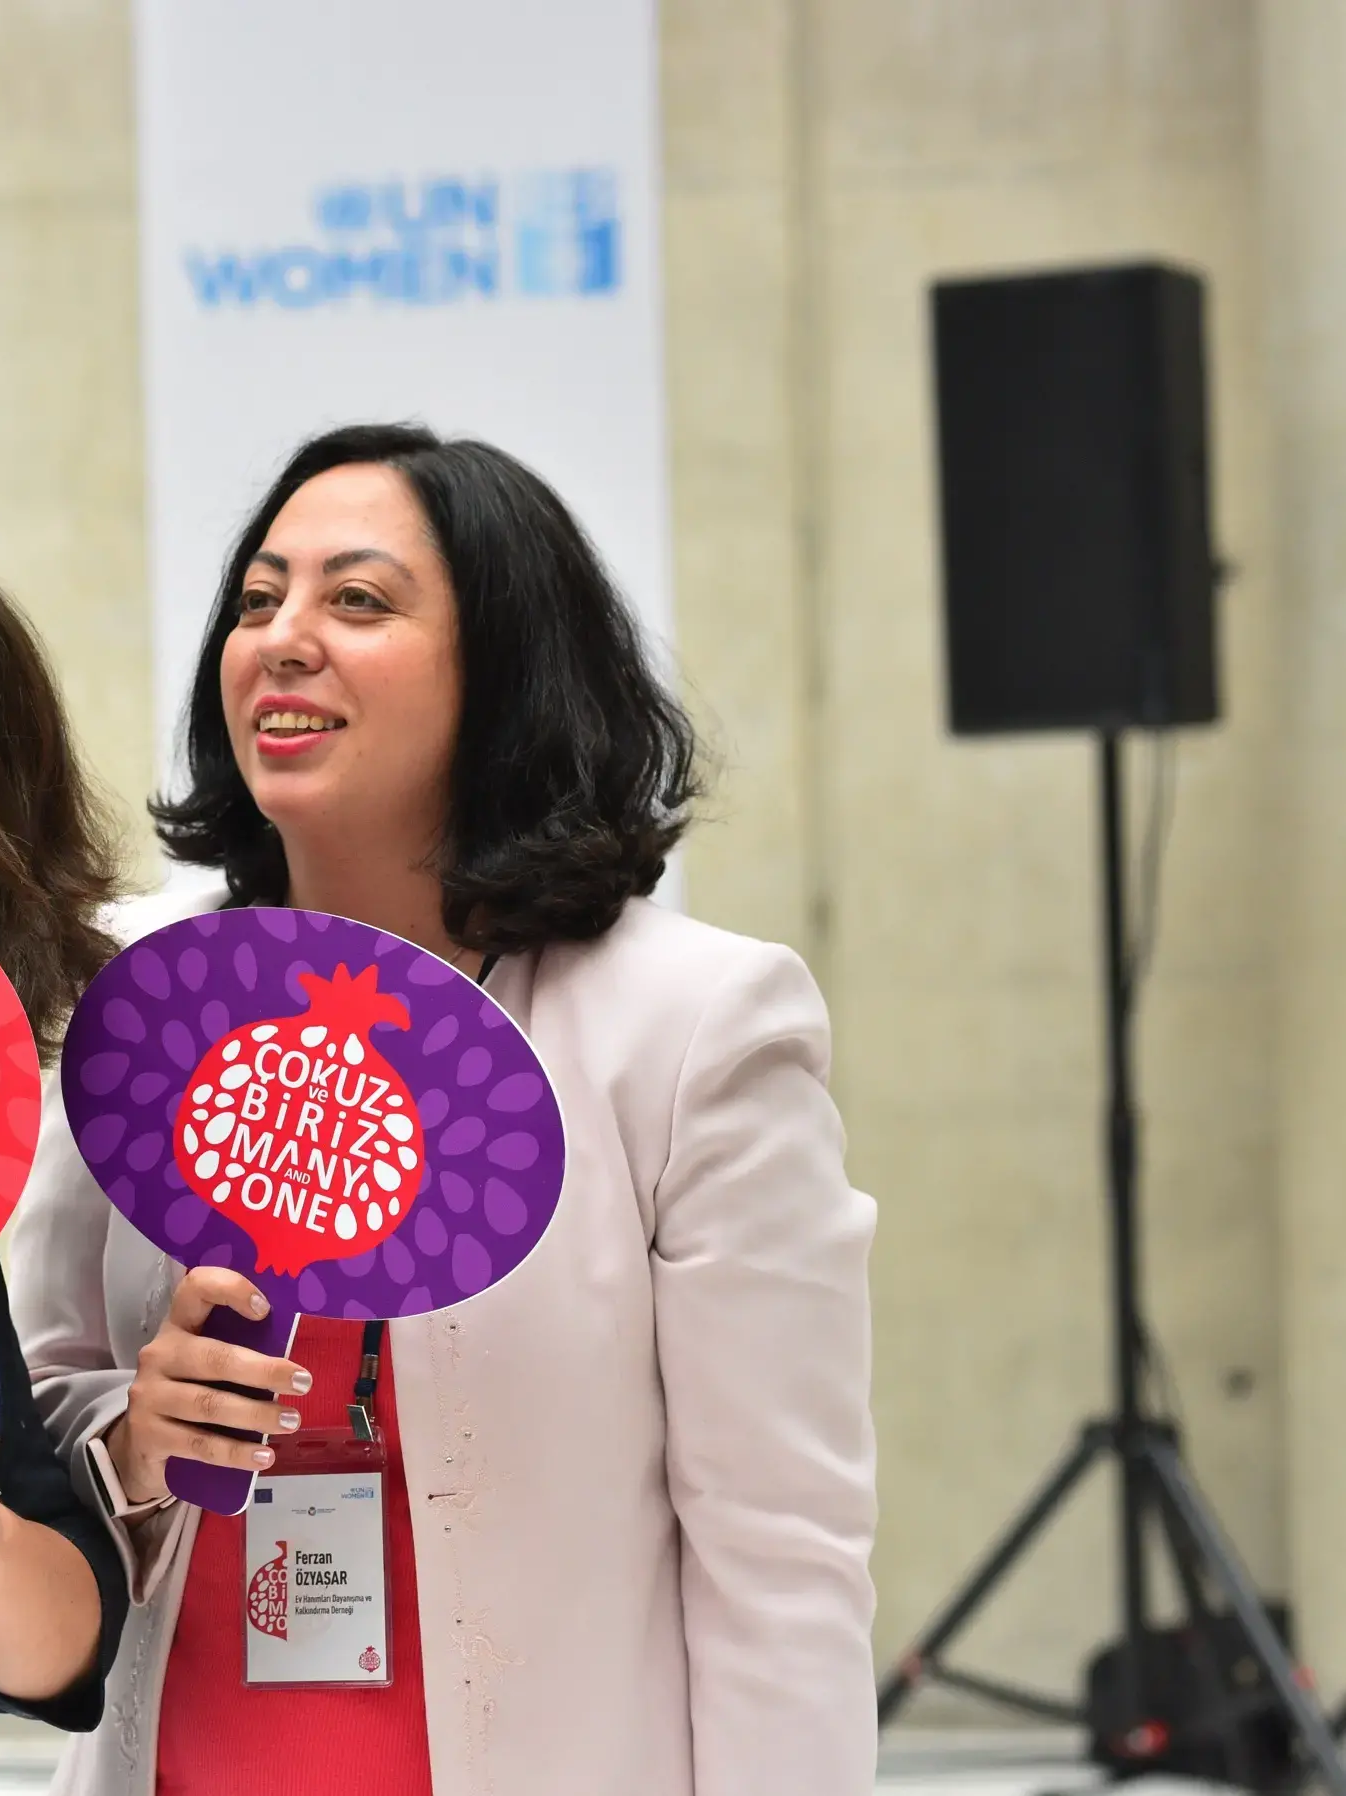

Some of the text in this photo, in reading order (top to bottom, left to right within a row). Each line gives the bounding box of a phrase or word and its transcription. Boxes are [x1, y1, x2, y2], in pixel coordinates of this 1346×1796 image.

[376, 178, 497, 231] UN
[185, 247, 498, 308] WOMEN
[254, 1042, 390, 1118] ÇOKUZ
[308, 1085, 329, 1103] ve
[230, 1122, 368, 1198] MANY
[284, 1167, 311, 1186] AND
[240, 1172, 334, 1234] ONE
[295, 1550, 333, 1565] Ferzan
[295, 1568, 348, 1589] ÖZYAŞAR
[295, 1595, 302, 1603] Ev
